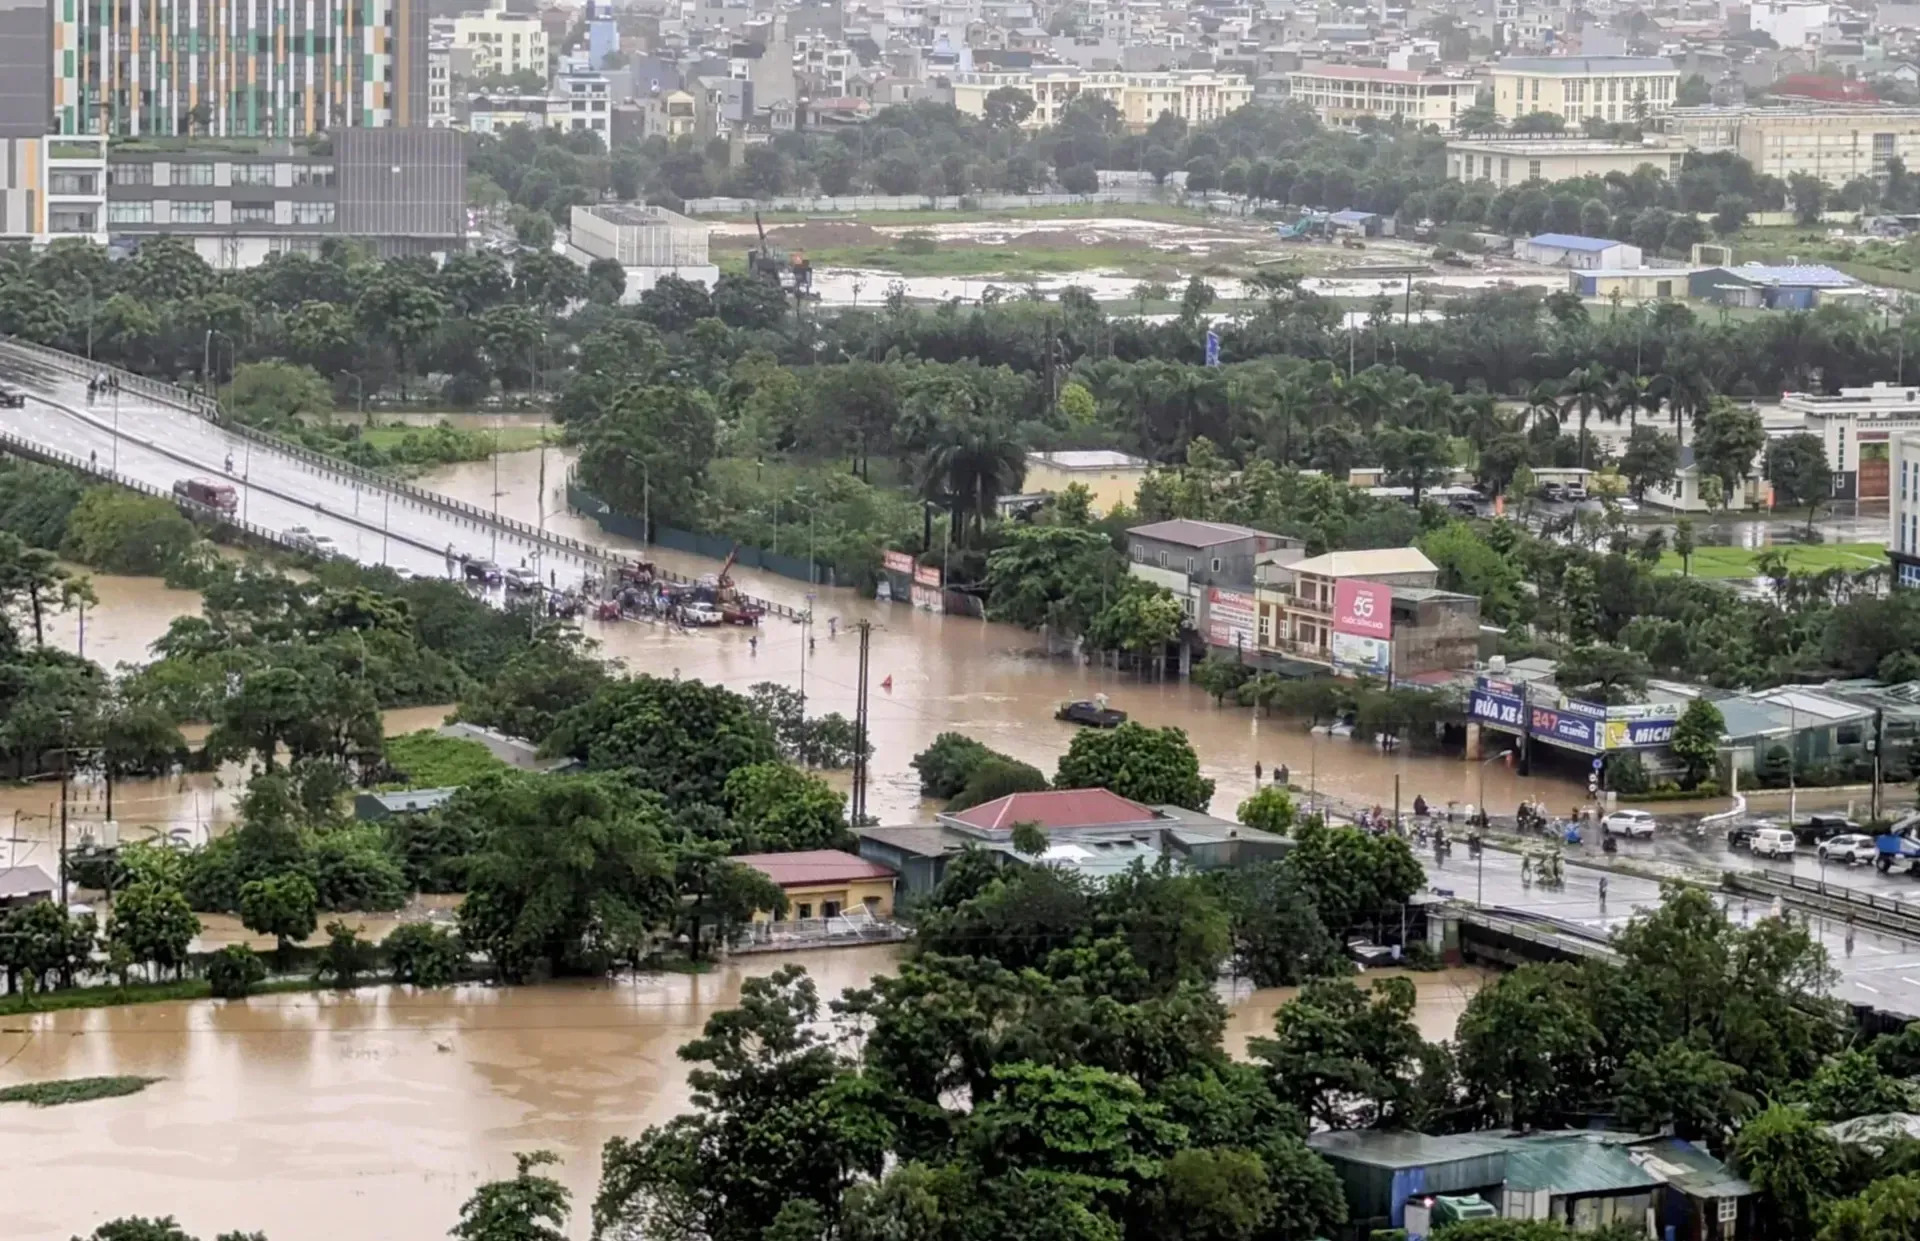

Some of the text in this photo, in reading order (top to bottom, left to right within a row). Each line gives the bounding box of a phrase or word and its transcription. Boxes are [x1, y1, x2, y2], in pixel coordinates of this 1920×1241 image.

[1353, 596, 1375, 617] 5G
[1474, 695, 1499, 719] RỬA
[1500, 704, 1517, 723] XE
[1569, 702, 1606, 718] MICHELIN
[1532, 709, 1558, 732] 247
[1634, 726, 1676, 743] MICH
